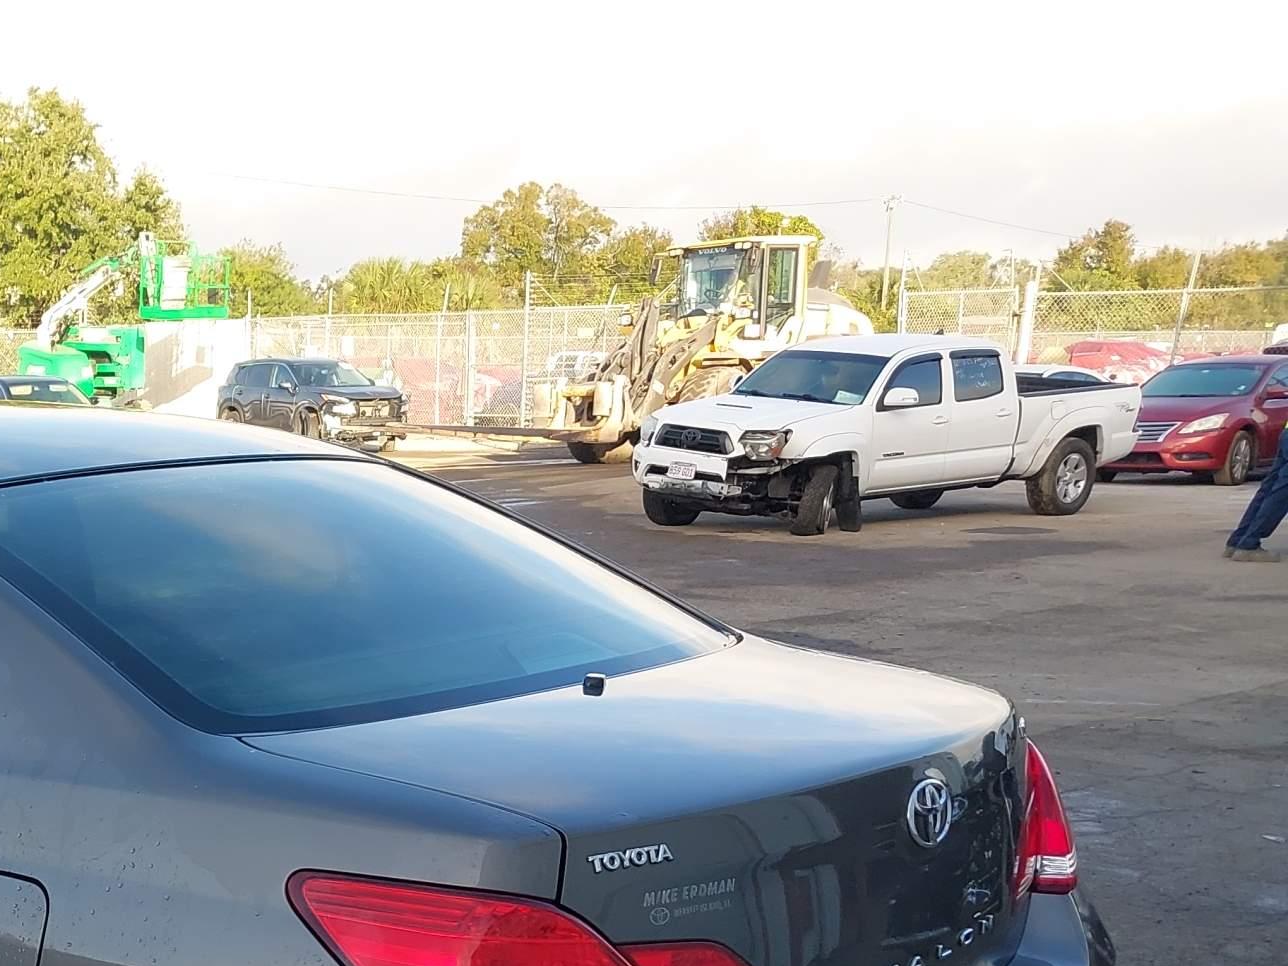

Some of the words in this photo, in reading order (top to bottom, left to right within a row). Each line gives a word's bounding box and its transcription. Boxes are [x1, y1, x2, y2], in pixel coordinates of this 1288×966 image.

[698, 247, 728, 255] VOLVO
[587, 843, 675, 873] TOYOTA
[643, 886, 679, 908] MIKE
[682, 877, 736, 900] ERDMAN
